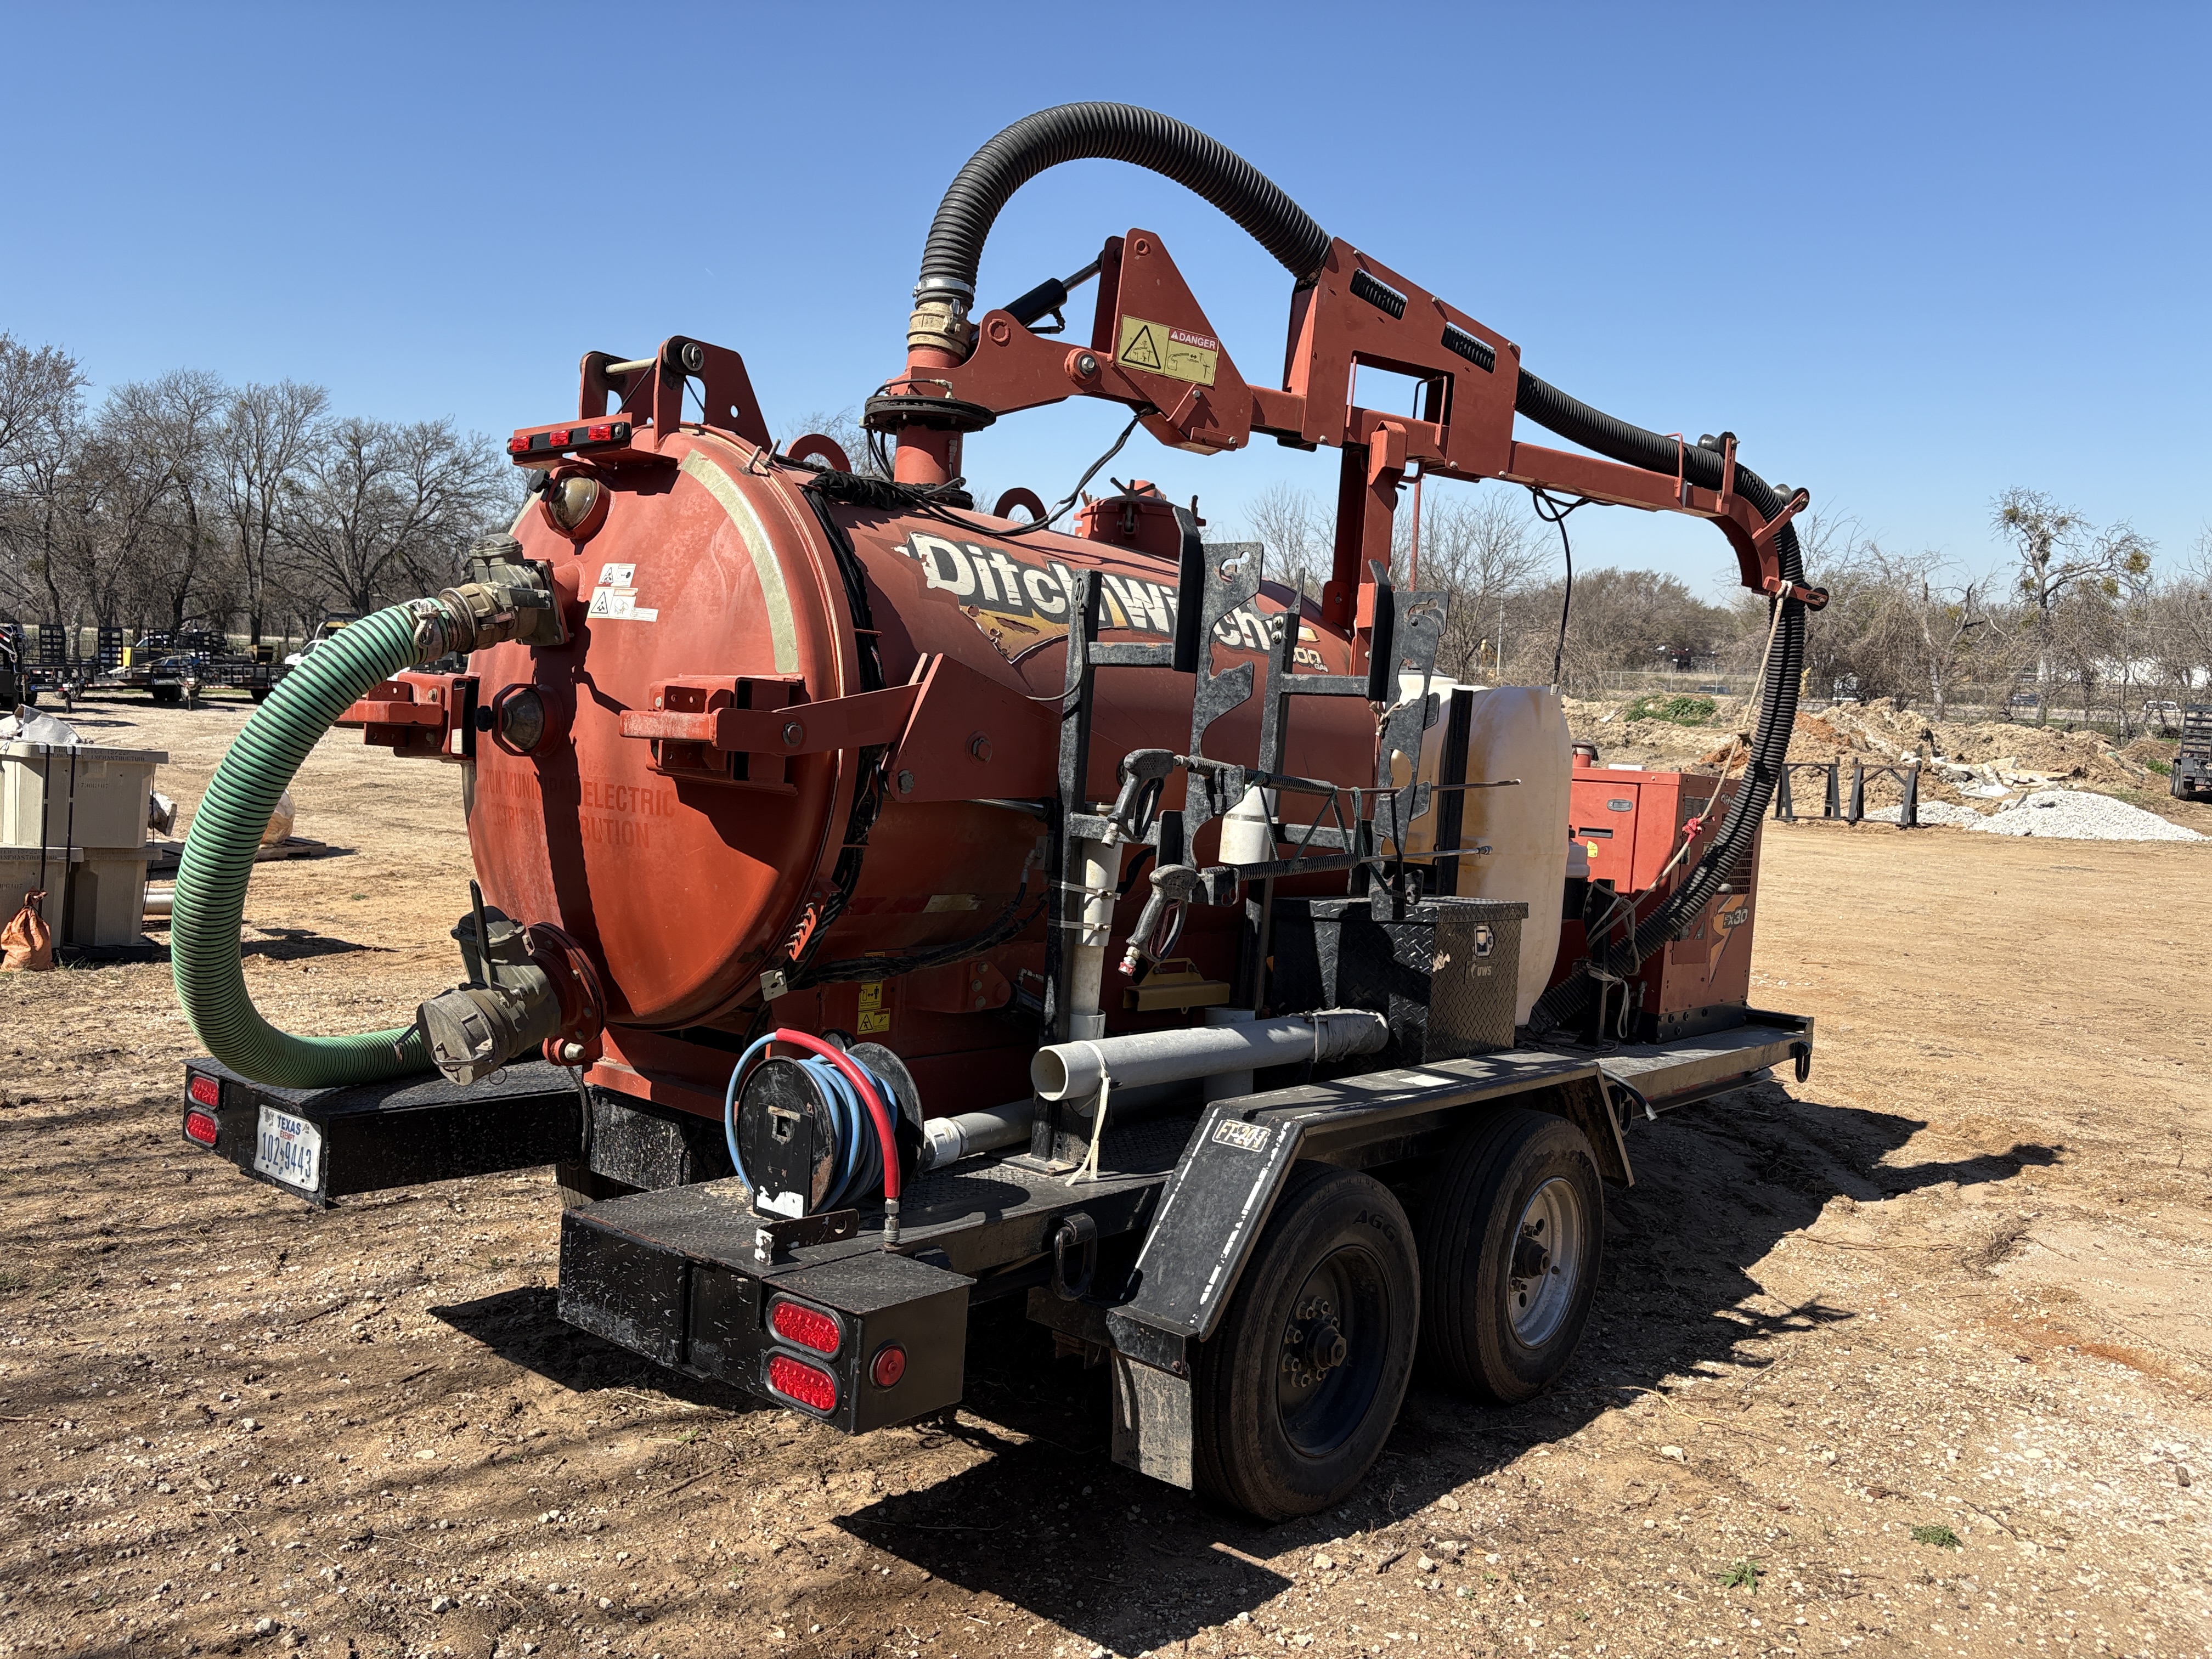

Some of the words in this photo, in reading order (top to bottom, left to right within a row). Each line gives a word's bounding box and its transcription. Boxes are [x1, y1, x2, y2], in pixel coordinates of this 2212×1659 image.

[1179, 332, 1216, 349] DANGER
[1102, 574, 1272, 651] Wich
[1293, 647, 1322, 665] 00
[583, 781, 676, 818] ELECTRIC
[1723, 909, 1748, 927] FX30
[1477, 966, 1492, 977] UWS
[278, 1114, 301, 1135] TEXAS
[280, 1130, 295, 1142] EXEMPT
